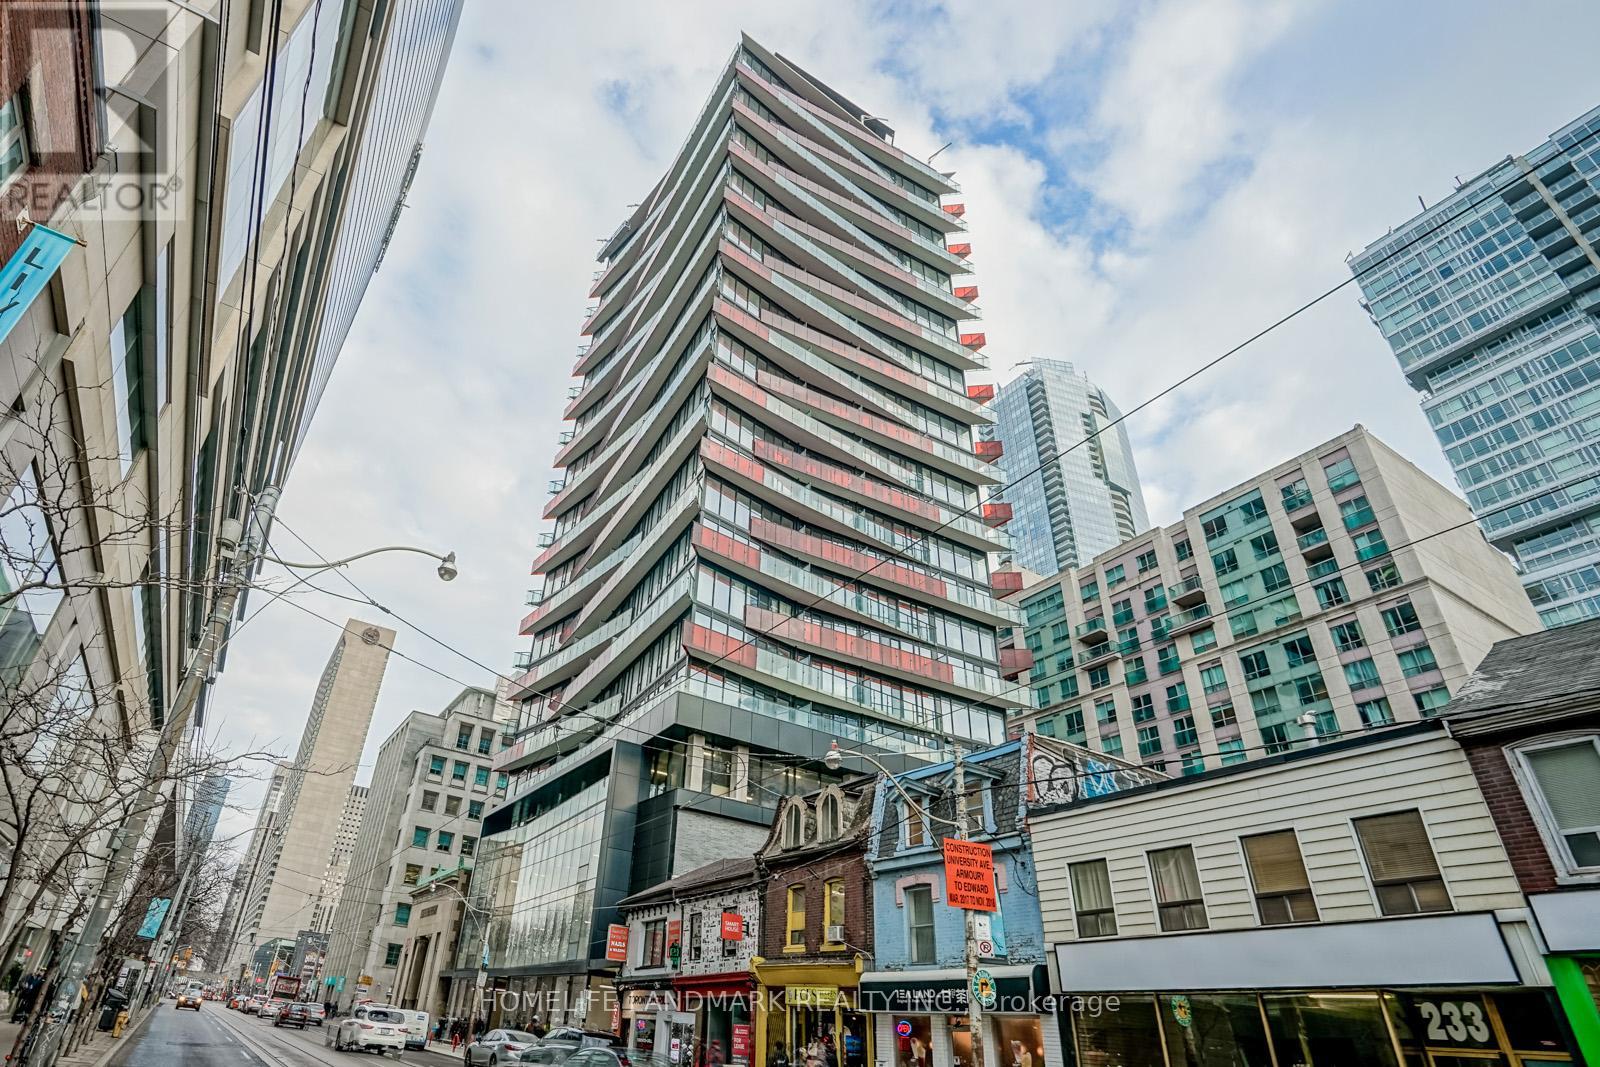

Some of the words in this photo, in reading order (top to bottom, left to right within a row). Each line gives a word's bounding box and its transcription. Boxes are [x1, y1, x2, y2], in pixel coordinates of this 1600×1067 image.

[945, 842, 991, 858] CONSTRUCTION
[946, 855, 979, 868] UNIVERSITY
[979, 860, 992, 870] AVE.
[956, 868, 985, 881] ARMOURY
[954, 880, 963, 891] TO
[963, 882, 989, 894] EDWARD
[895, 989, 911, 998] TEA
[911, 989, 935, 998] LAND
[1419, 1001, 1490, 1043] 233
